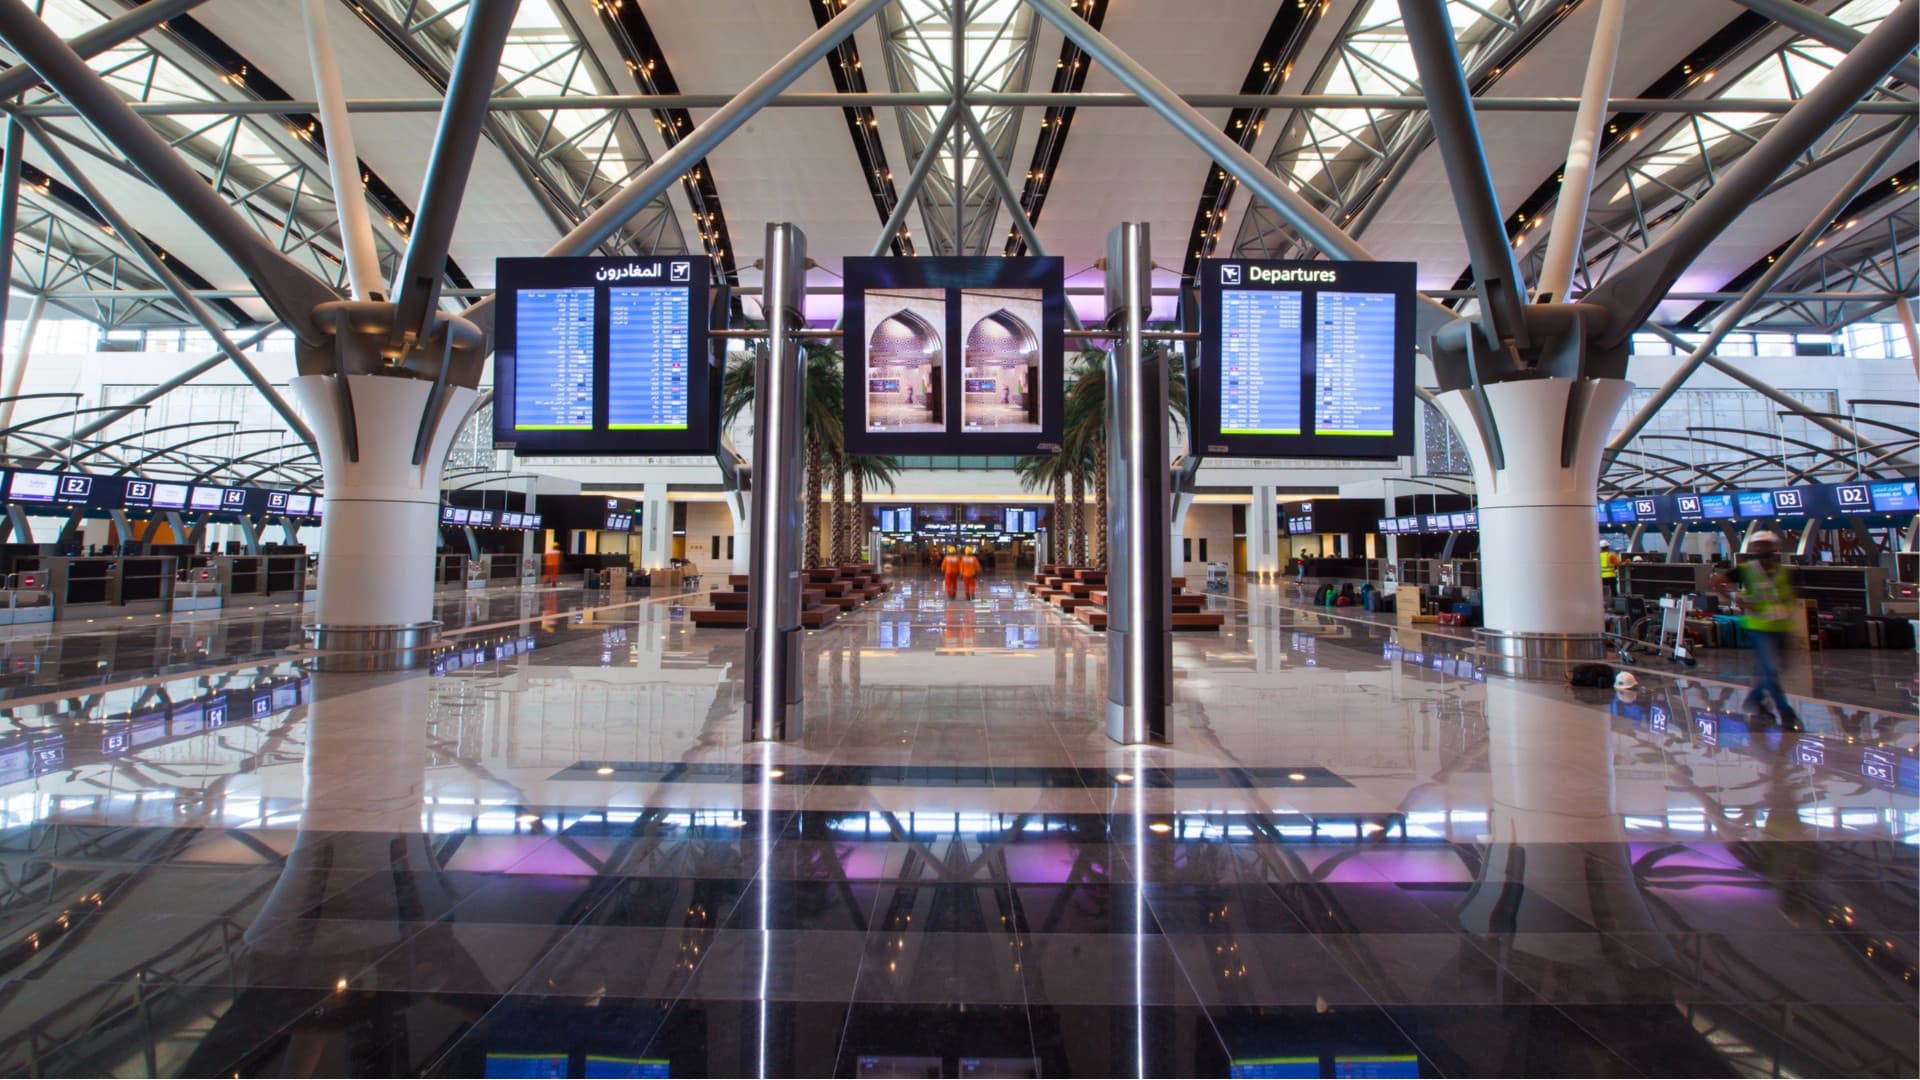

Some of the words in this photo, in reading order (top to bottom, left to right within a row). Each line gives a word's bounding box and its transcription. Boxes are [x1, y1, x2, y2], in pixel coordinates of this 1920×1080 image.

[595, 263, 662, 281] المغادرون
[1249, 266, 1337, 285] Departures
[67, 479, 84, 492] E2
[132, 484, 147, 497] E3
[228, 492, 241, 503] E4
[272, 495, 283, 505] E5
[1780, 494, 1797, 506] D3
[1843, 490, 1863, 502] D2
[1638, 503, 1652, 513] D5
[1682, 501, 1696, 511] D4
